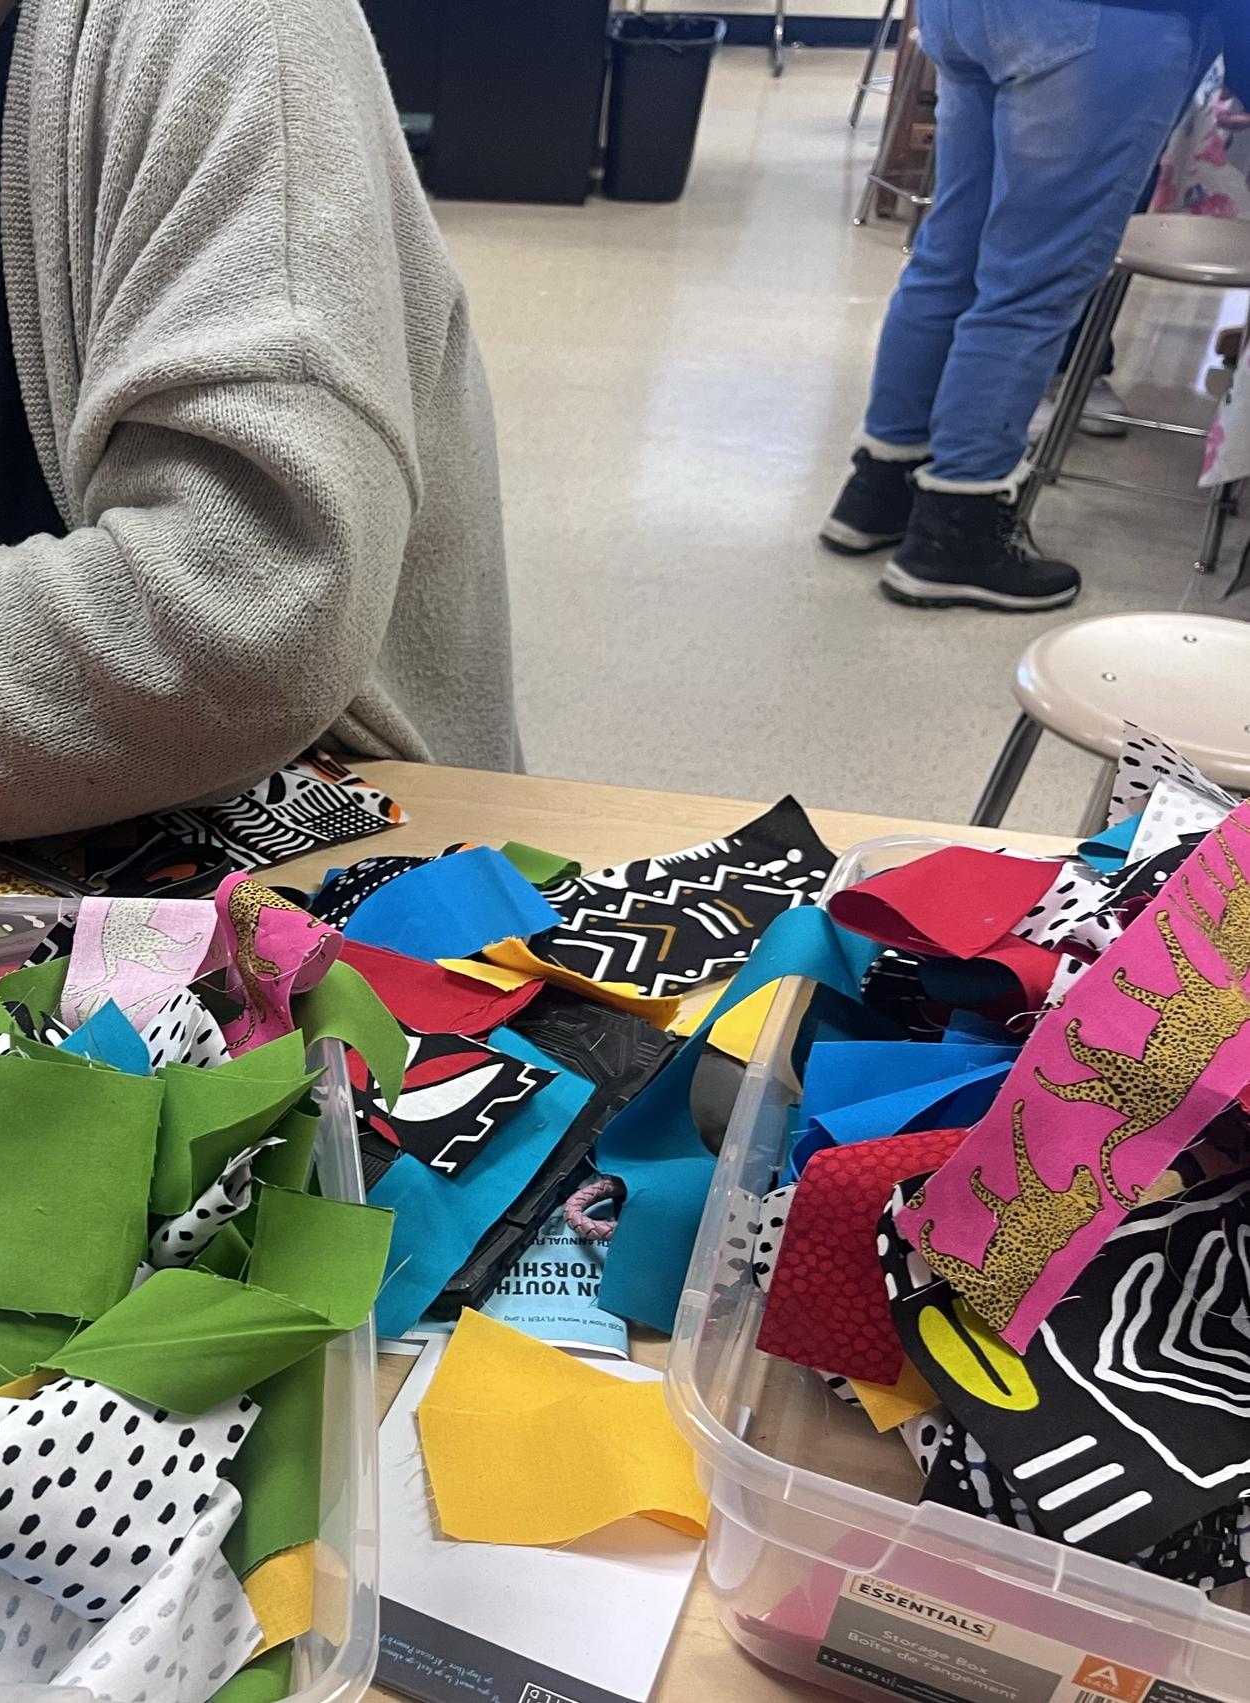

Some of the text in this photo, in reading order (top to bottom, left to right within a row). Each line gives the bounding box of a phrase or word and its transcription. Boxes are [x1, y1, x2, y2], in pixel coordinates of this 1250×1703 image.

[528, 1315, 555, 1323] FLYER
[588, 1320, 607, 1328] How
[862, 1575, 917, 1599] STORAGE
[858, 1583, 987, 1637] ESSENTIALS
[882, 1630, 989, 1676] Storage Box
[896, 1651, 919, 1664] de
[923, 1662, 1018, 1700] rangement
[1088, 1665, 1118, 1686] A
